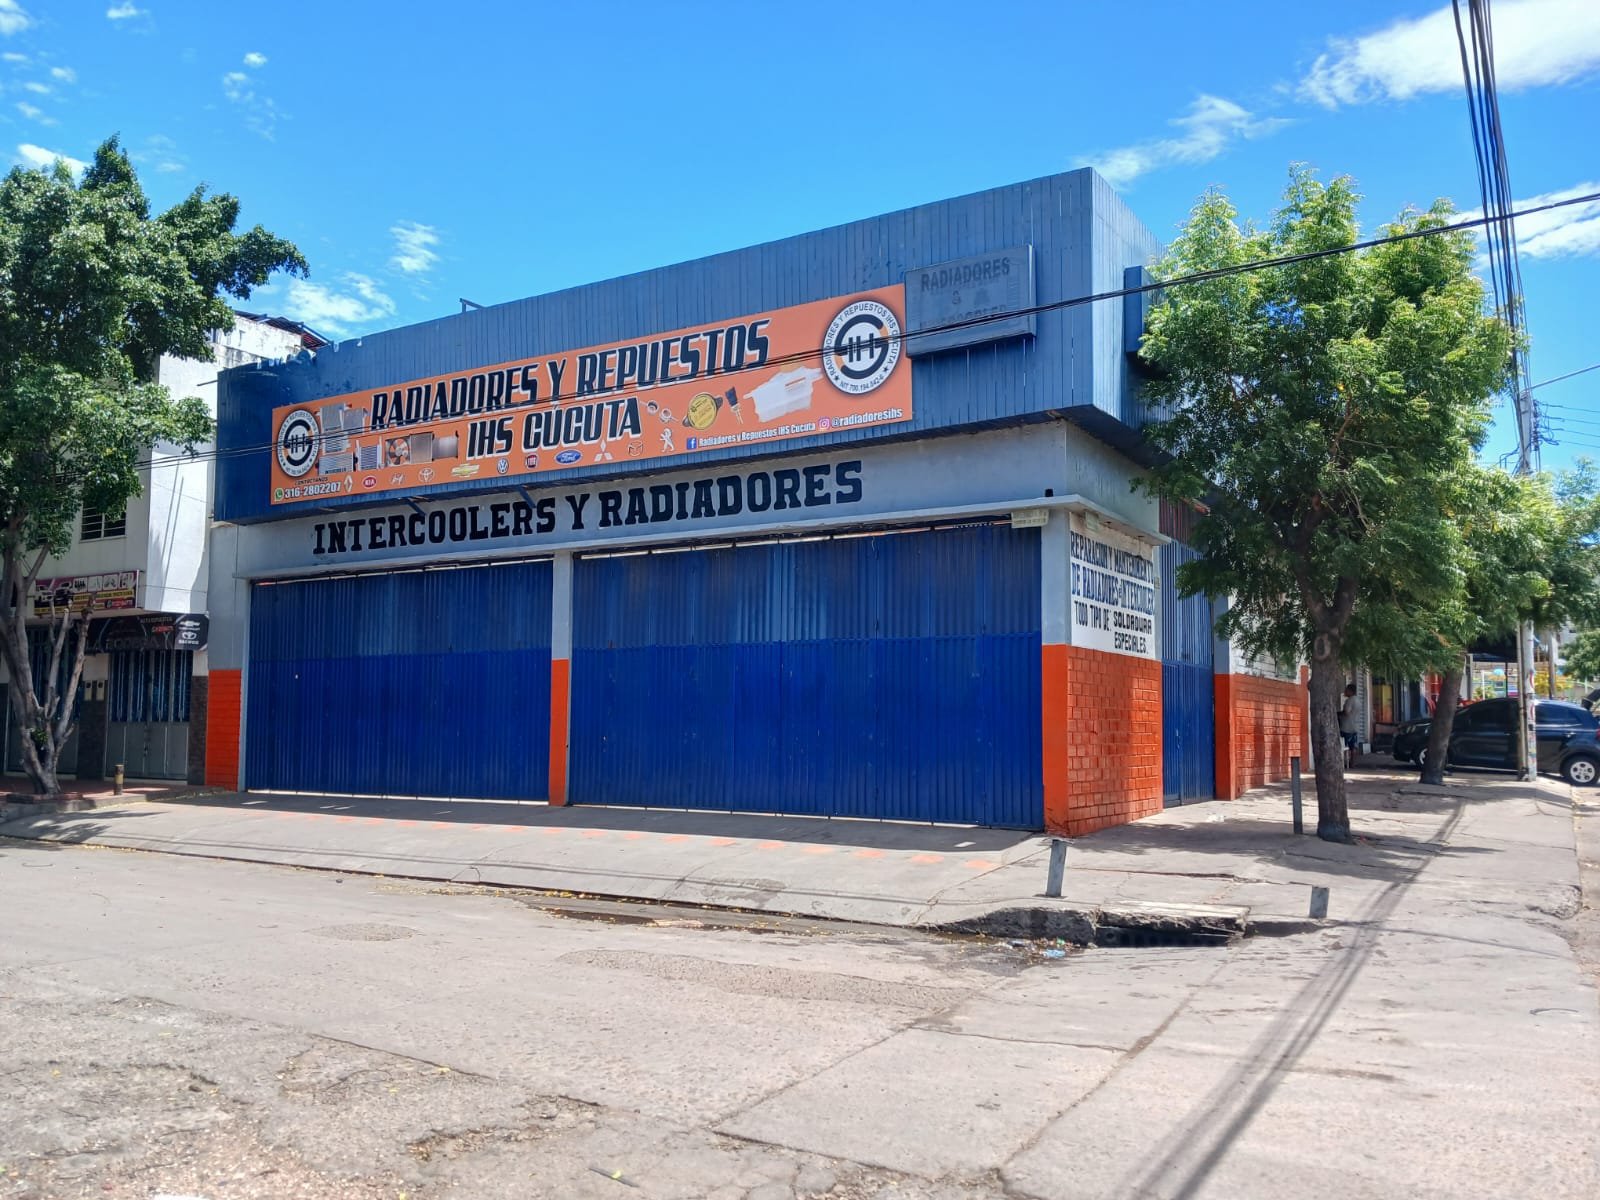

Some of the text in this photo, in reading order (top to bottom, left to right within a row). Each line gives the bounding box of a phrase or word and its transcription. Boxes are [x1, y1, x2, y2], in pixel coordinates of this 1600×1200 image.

[921, 257, 1010, 292] RADIADORES
[844, 303, 887, 317] REPUESTOS
[370, 318, 772, 433] RADIADORES Y REPUESTOS
[466, 415, 514, 460] IHS
[699, 435, 737, 447] Radiadores
[736, 435, 742, 444] y
[741, 428, 778, 441] Repuestos
[284, 481, 342, 499] 316-2802207
[313, 460, 863, 554] INTERCOOLERS Y RADIADORES
[1071, 562, 1081, 597] DE
[1082, 566, 1118, 606] RADIADORES
[1089, 605, 1102, 629] TIPO
[1113, 610, 1152, 635] SOLDADURA
